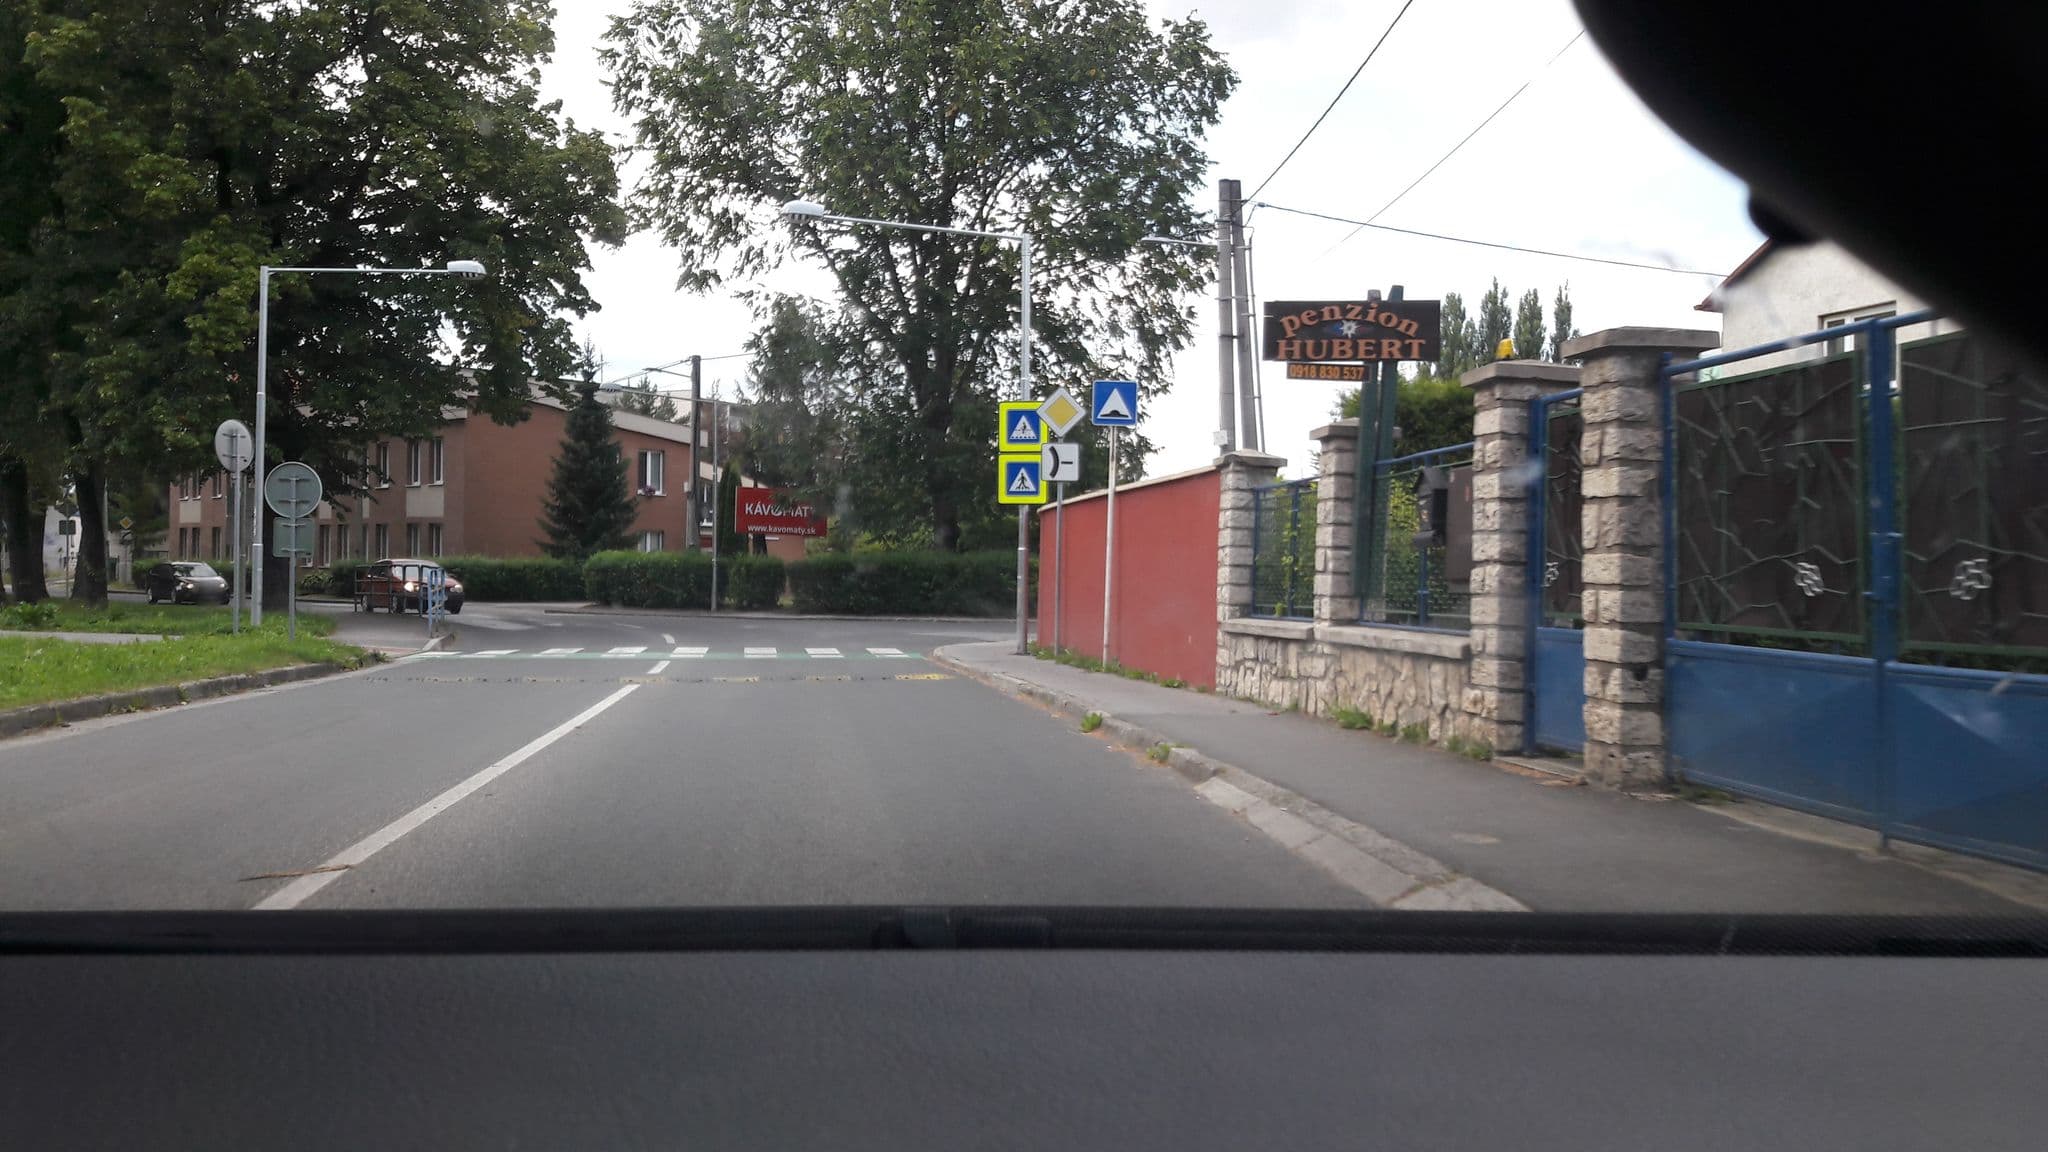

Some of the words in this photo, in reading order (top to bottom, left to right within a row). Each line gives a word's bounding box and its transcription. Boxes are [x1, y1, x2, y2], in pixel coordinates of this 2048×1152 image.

[1280, 303, 1419, 337] penzion
[1277, 339, 1426, 360] HUBERT
[1290, 364, 1316, 378] 0918
[747, 525, 816, 535] www.kavomaty.sk
